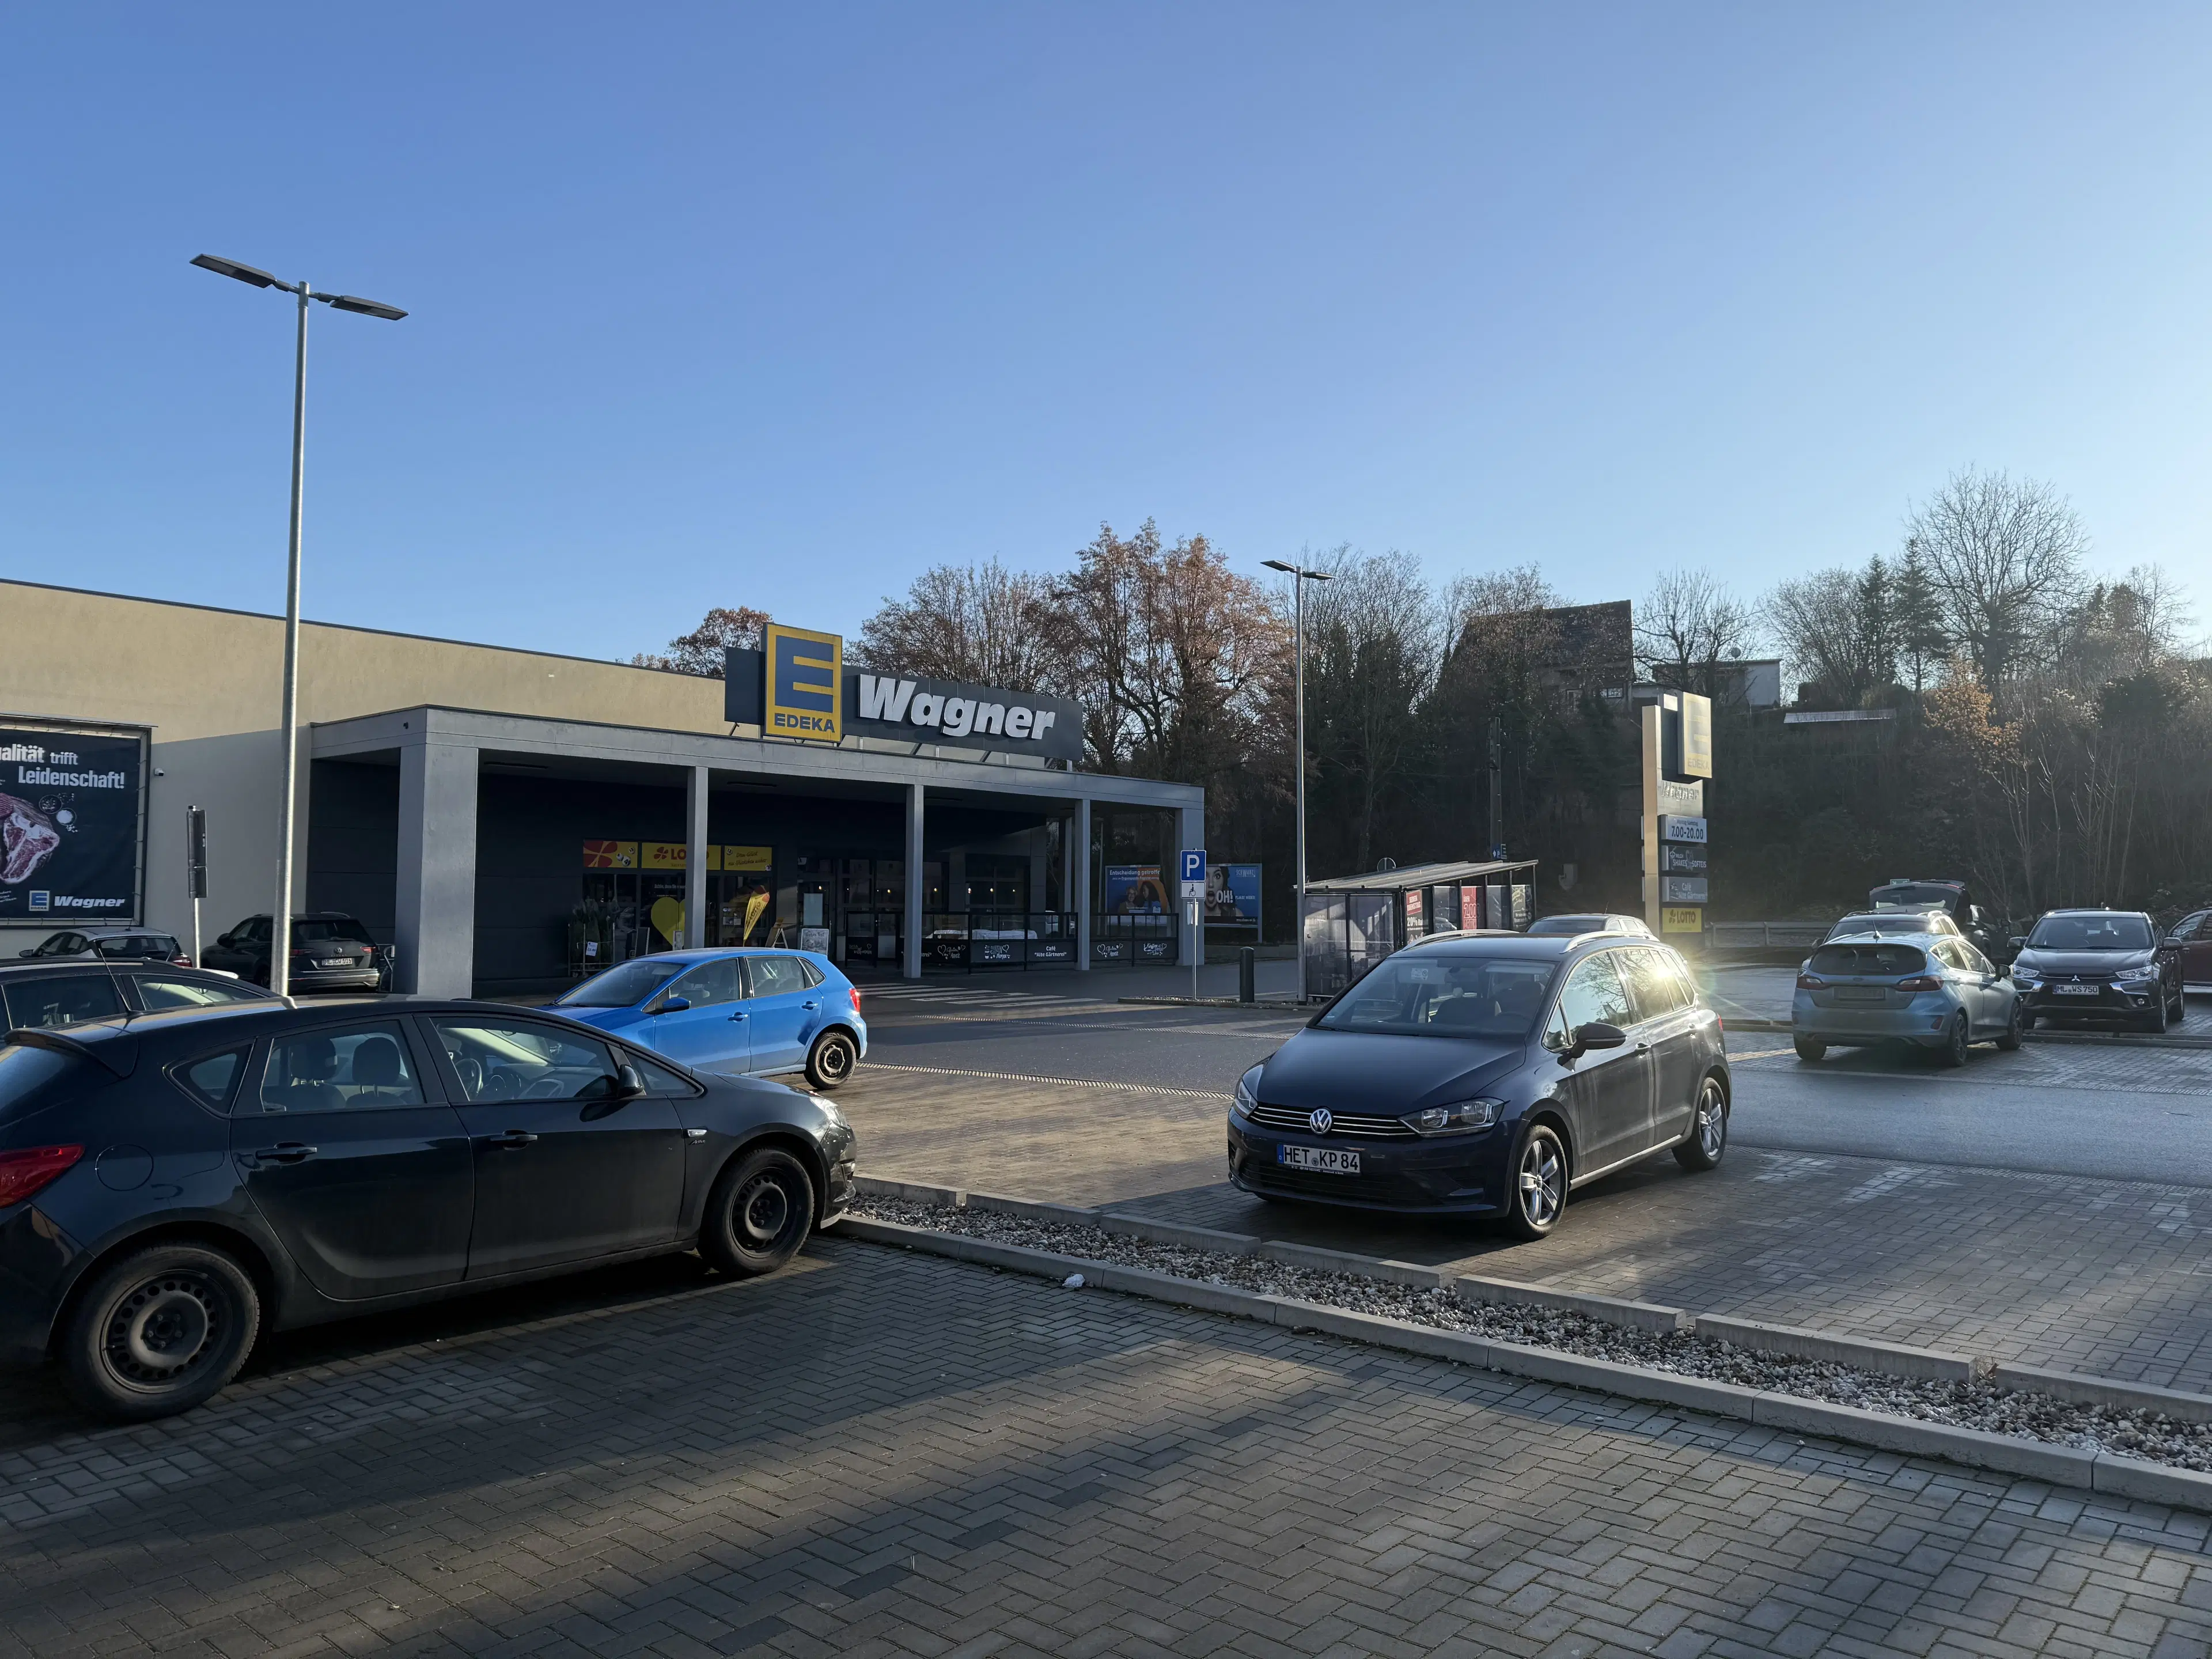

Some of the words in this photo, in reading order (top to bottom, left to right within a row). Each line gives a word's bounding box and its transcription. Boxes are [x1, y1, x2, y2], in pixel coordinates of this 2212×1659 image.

[859, 673, 1056, 740] Wagner
[774, 713, 835, 733] EDEKA
[0, 744, 46, 763] alität
[50, 752, 78, 765] trifft
[1688, 757, 1710, 770] EDEKA
[18, 766, 124, 789] Leidenschaft!
[1662, 781, 1699, 801] Wagner
[1672, 825, 1703, 839] 7.00-20.00
[1187, 854, 1200, 877] P
[54, 896, 126, 908] Wagner
[1216, 890, 1233, 903] OH!
[1407, 917, 1417, 926] 20%
[1677, 910, 1696, 924] LOTTO
[1284, 1146, 1310, 1164] HET
[1319, 1150, 1337, 1168] KP
[1341, 1153, 1358, 1171] 84
